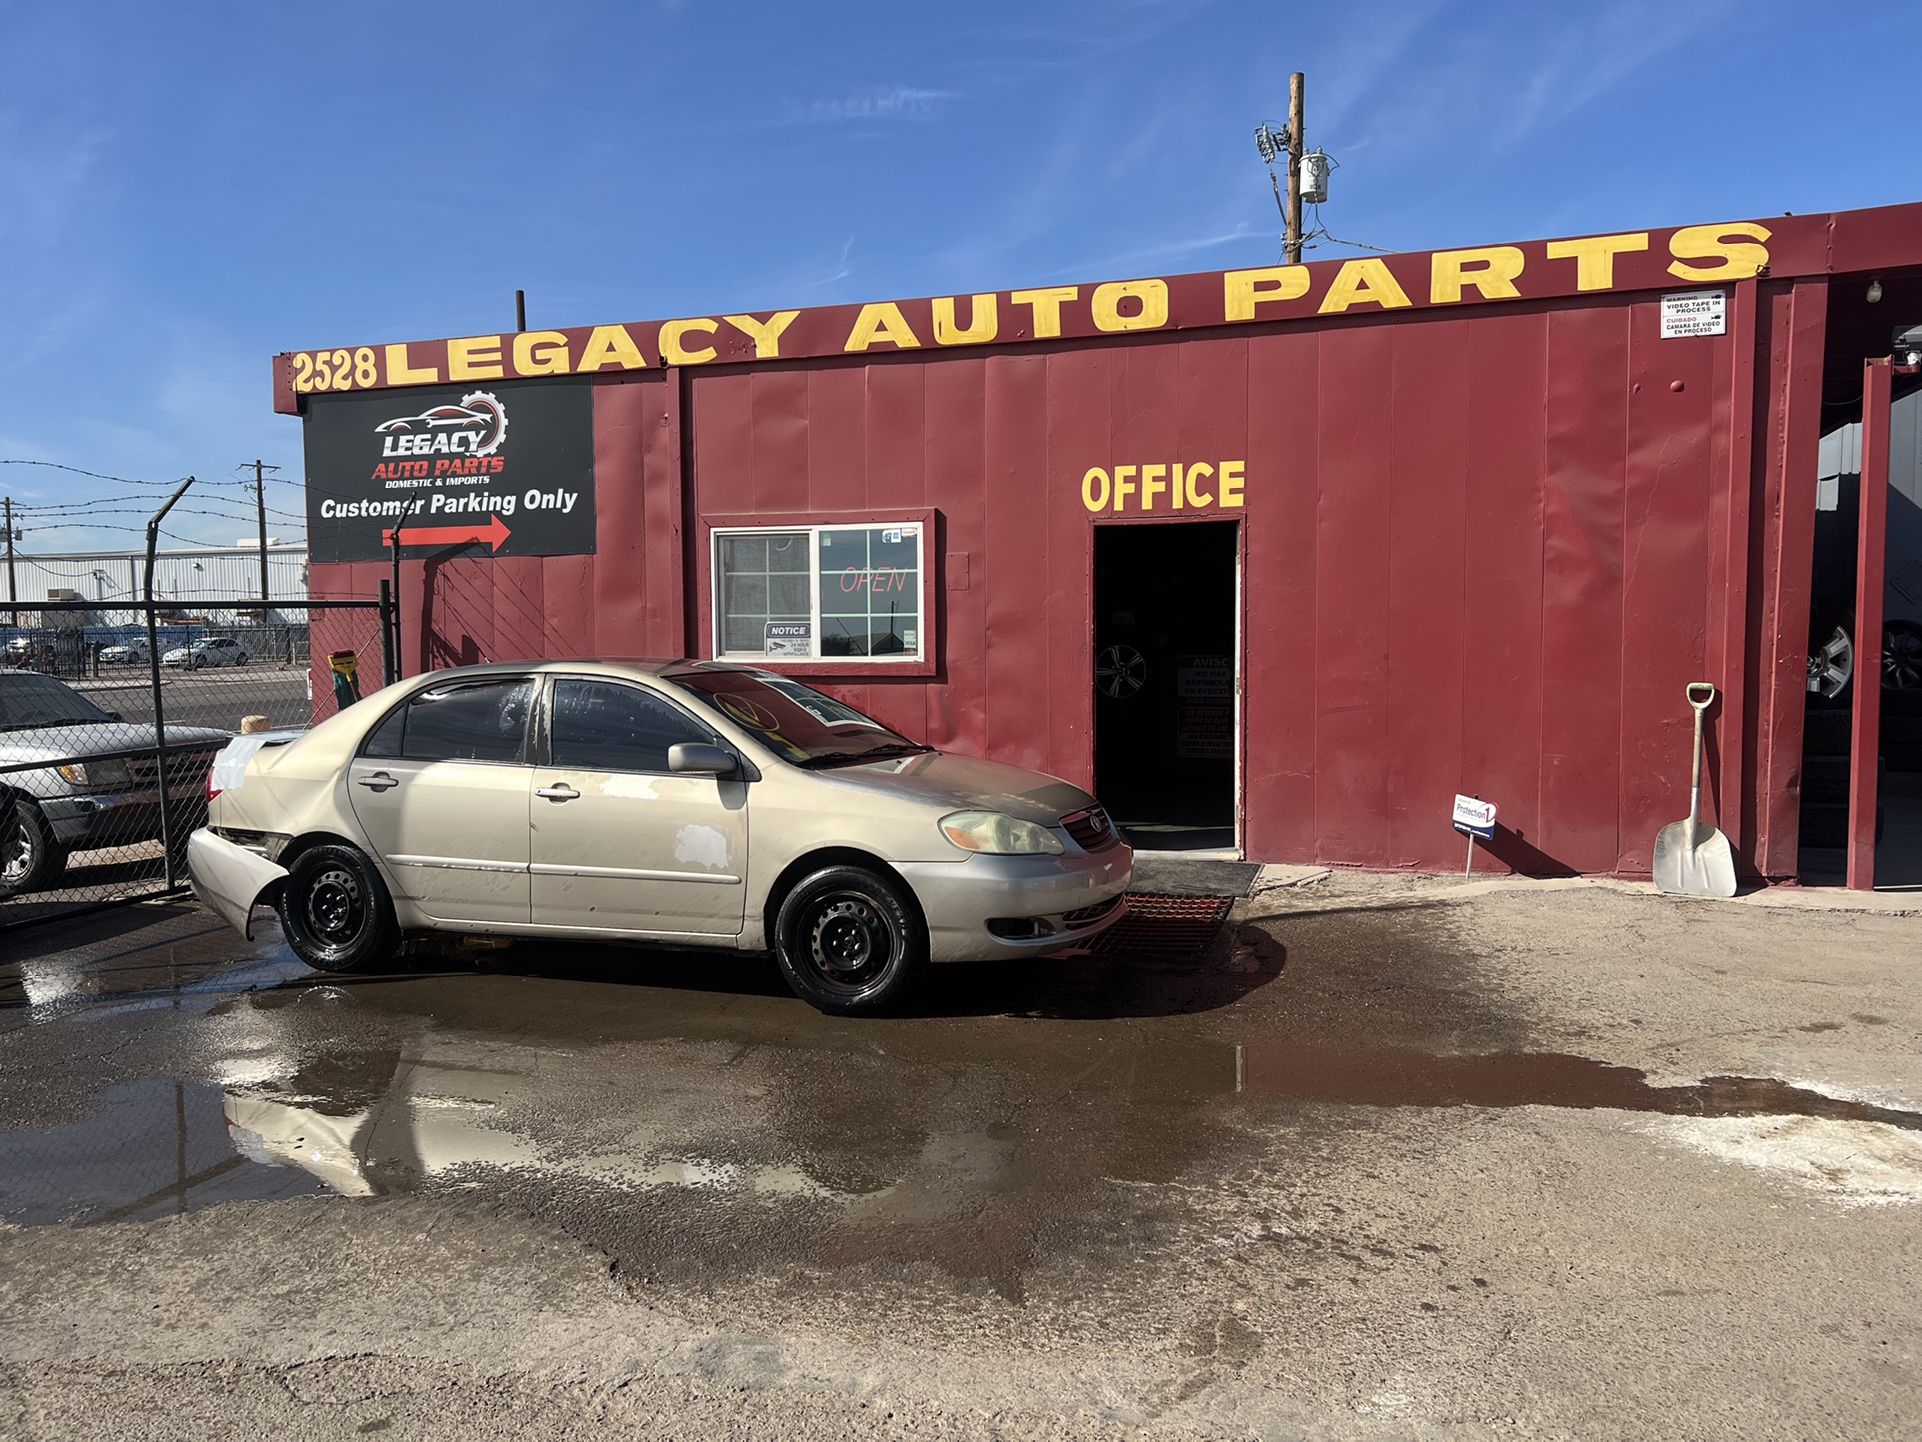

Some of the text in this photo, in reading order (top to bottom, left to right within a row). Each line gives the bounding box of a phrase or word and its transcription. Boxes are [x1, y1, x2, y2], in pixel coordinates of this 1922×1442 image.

[292, 222, 1773, 392] 2528 LEGACY AUTO PARTS
[1676, 306, 1711, 314] PROCESS
[382, 429, 487, 457] LEGACY
[371, 456, 505, 480] AUTO PARTS
[385, 475, 491, 489] DOMESTIC & IMPORTS
[1081, 460, 1245, 513] OFFICE
[320, 488, 579, 519] Customer Parking Only
[840, 566, 908, 592] OPEN
[771, 626, 806, 635] NOTICE
[1456, 803, 1485, 819] Protection
